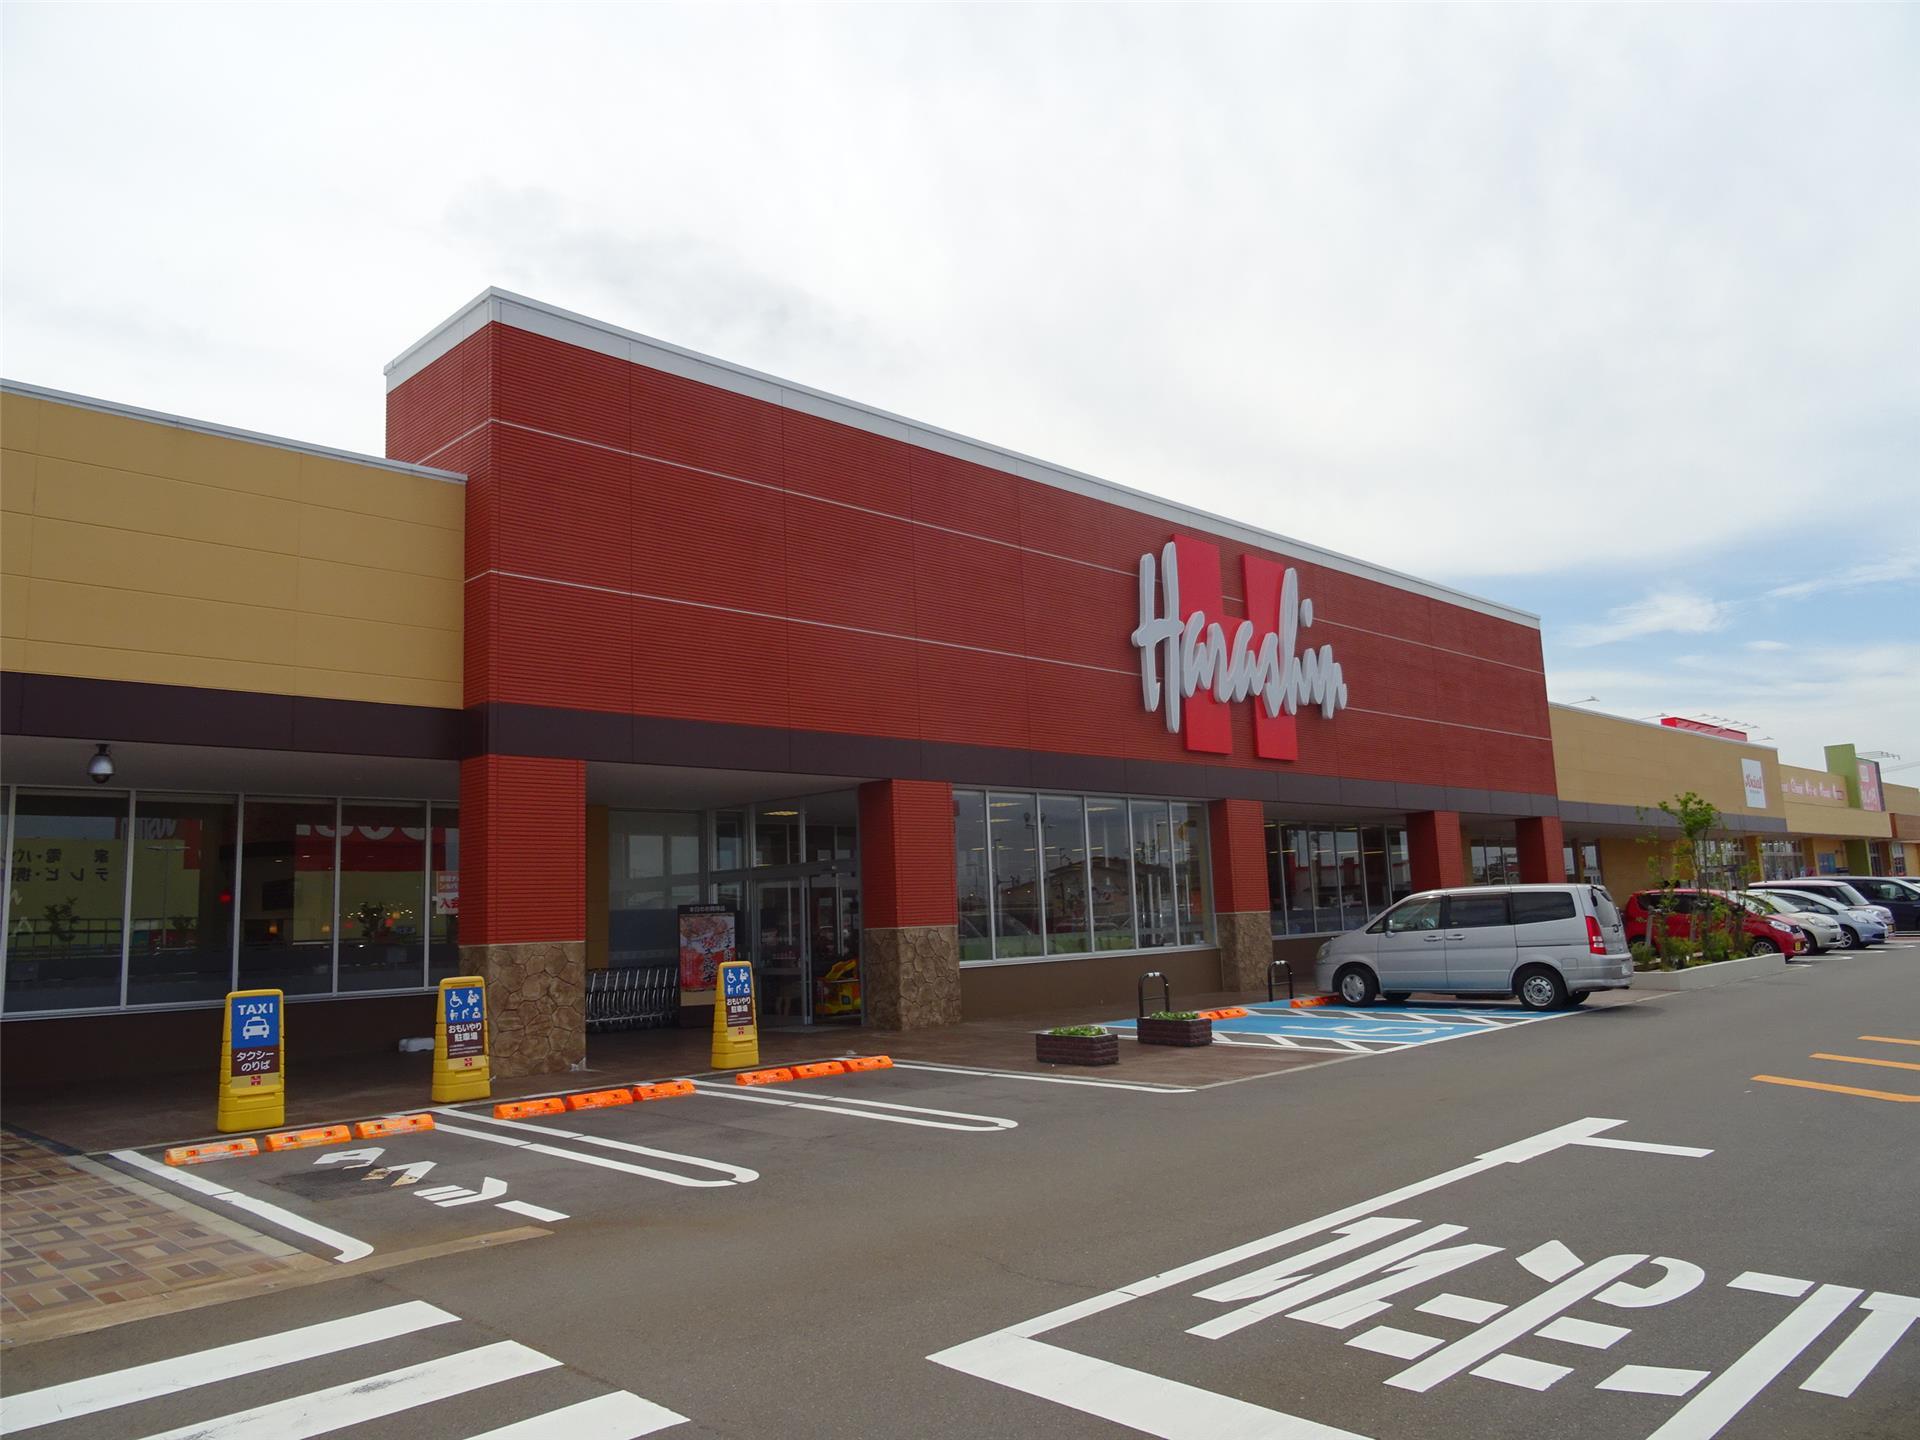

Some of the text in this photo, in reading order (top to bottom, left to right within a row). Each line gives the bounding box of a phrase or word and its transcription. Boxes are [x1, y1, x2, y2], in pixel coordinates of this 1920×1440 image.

[1131, 541, 1348, 733] Harashin
[726, 998, 751, 1006] おもいやり
[237, 1002, 273, 1015] TAXI
[448, 1022, 482, 1034] おもいやり
[454, 1032, 478, 1042] 駐車場
[236, 1050, 275, 1062] タクシー
[241, 1059, 271, 1072] のりば
